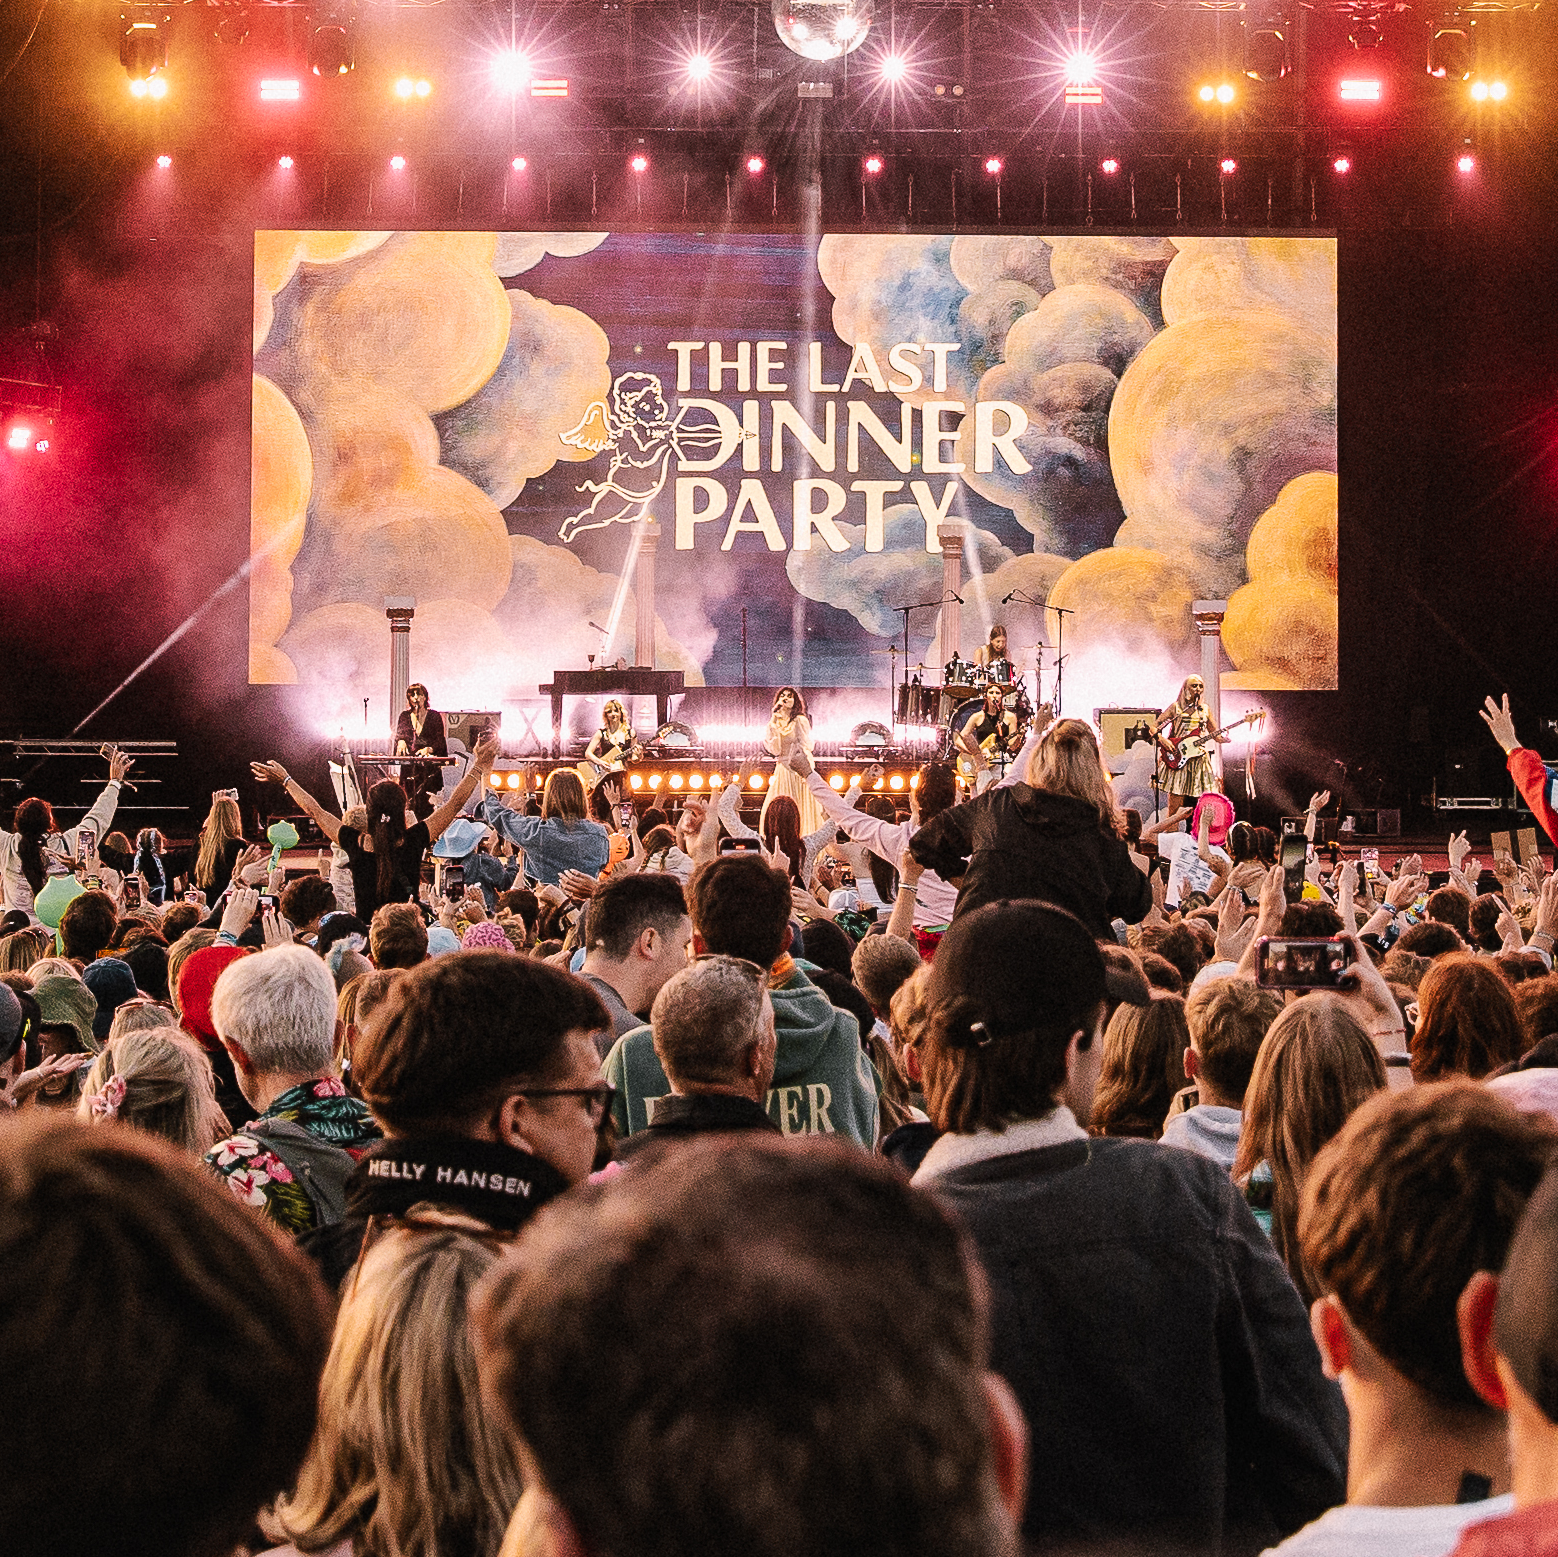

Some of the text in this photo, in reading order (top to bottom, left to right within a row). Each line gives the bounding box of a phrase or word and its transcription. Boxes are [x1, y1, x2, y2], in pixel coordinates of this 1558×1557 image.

[667, 341, 962, 394] THE LAST
[675, 398, 1034, 475] DINNER
[674, 477, 959, 554] PARTY
[368, 1159, 532, 1198] HELLY HANSEN
